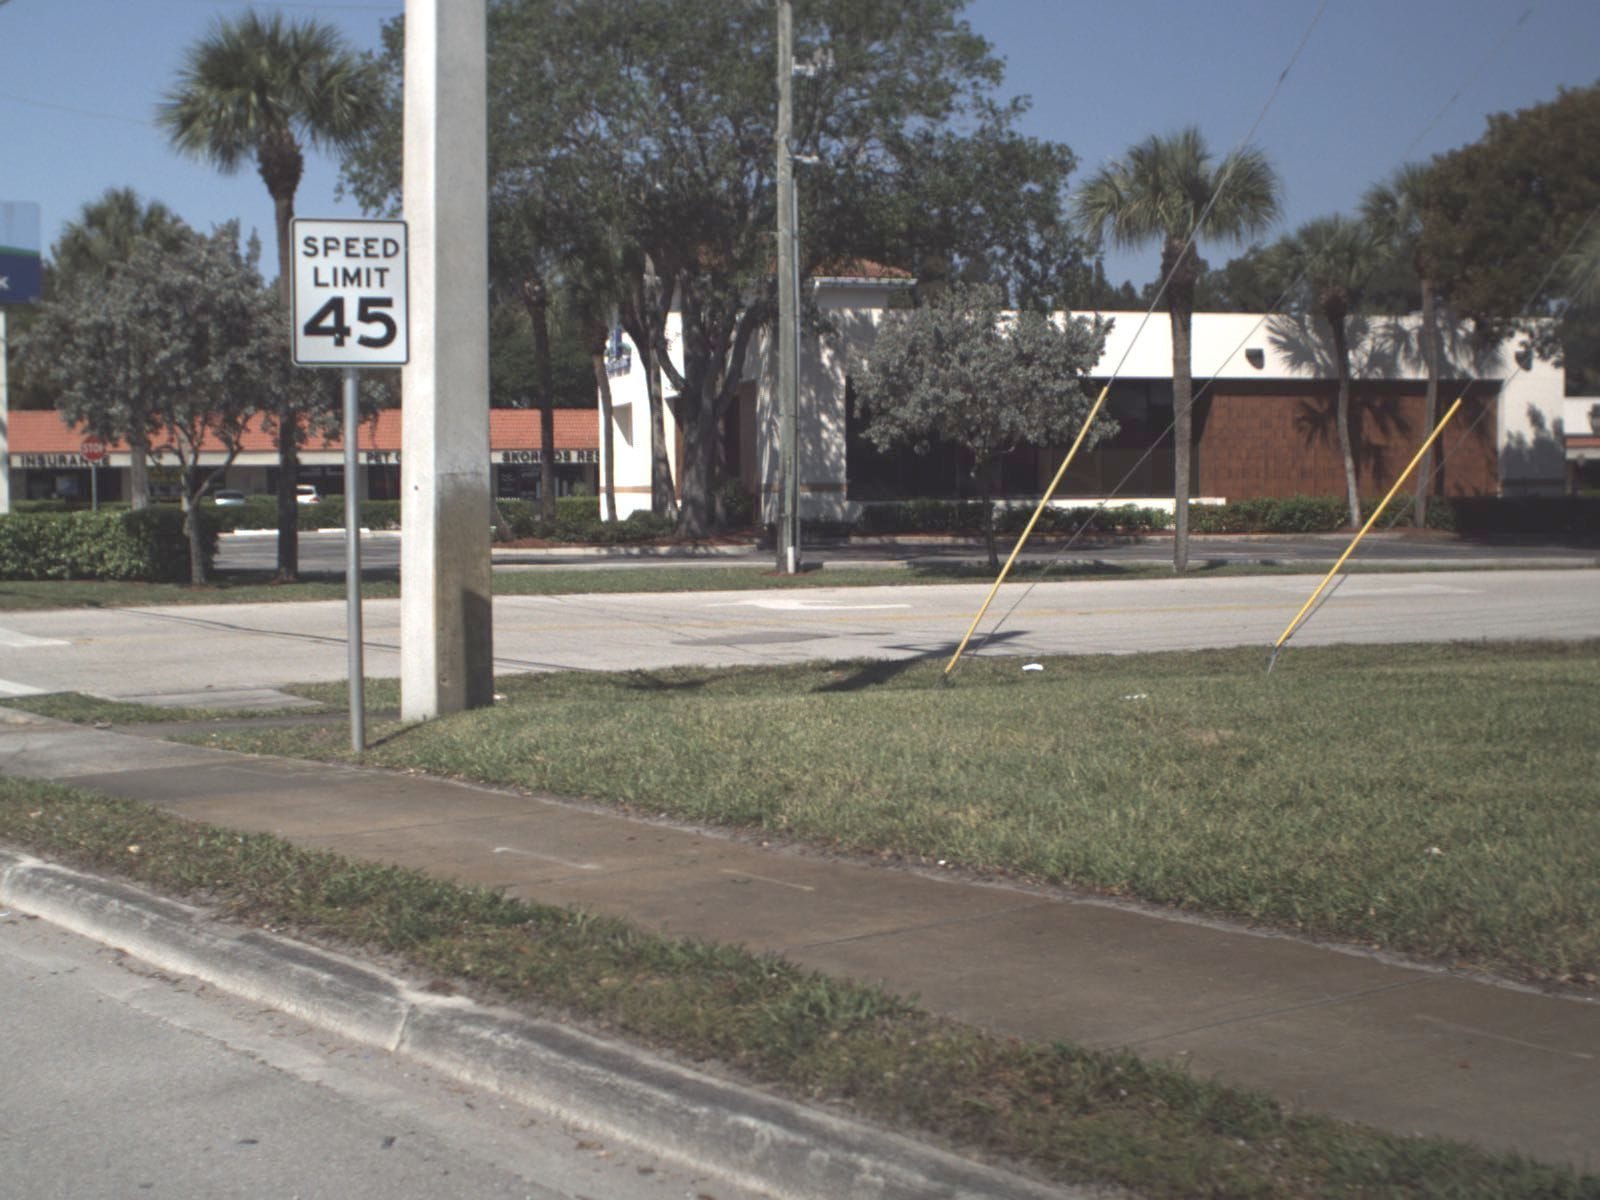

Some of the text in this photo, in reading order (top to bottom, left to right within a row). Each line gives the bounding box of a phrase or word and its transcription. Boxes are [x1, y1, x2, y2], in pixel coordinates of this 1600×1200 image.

[302, 236, 400, 258] SPEED
[313, 266, 390, 288] LIMIT
[303, 296, 398, 349] 45
[83, 442, 105, 453] STOP
